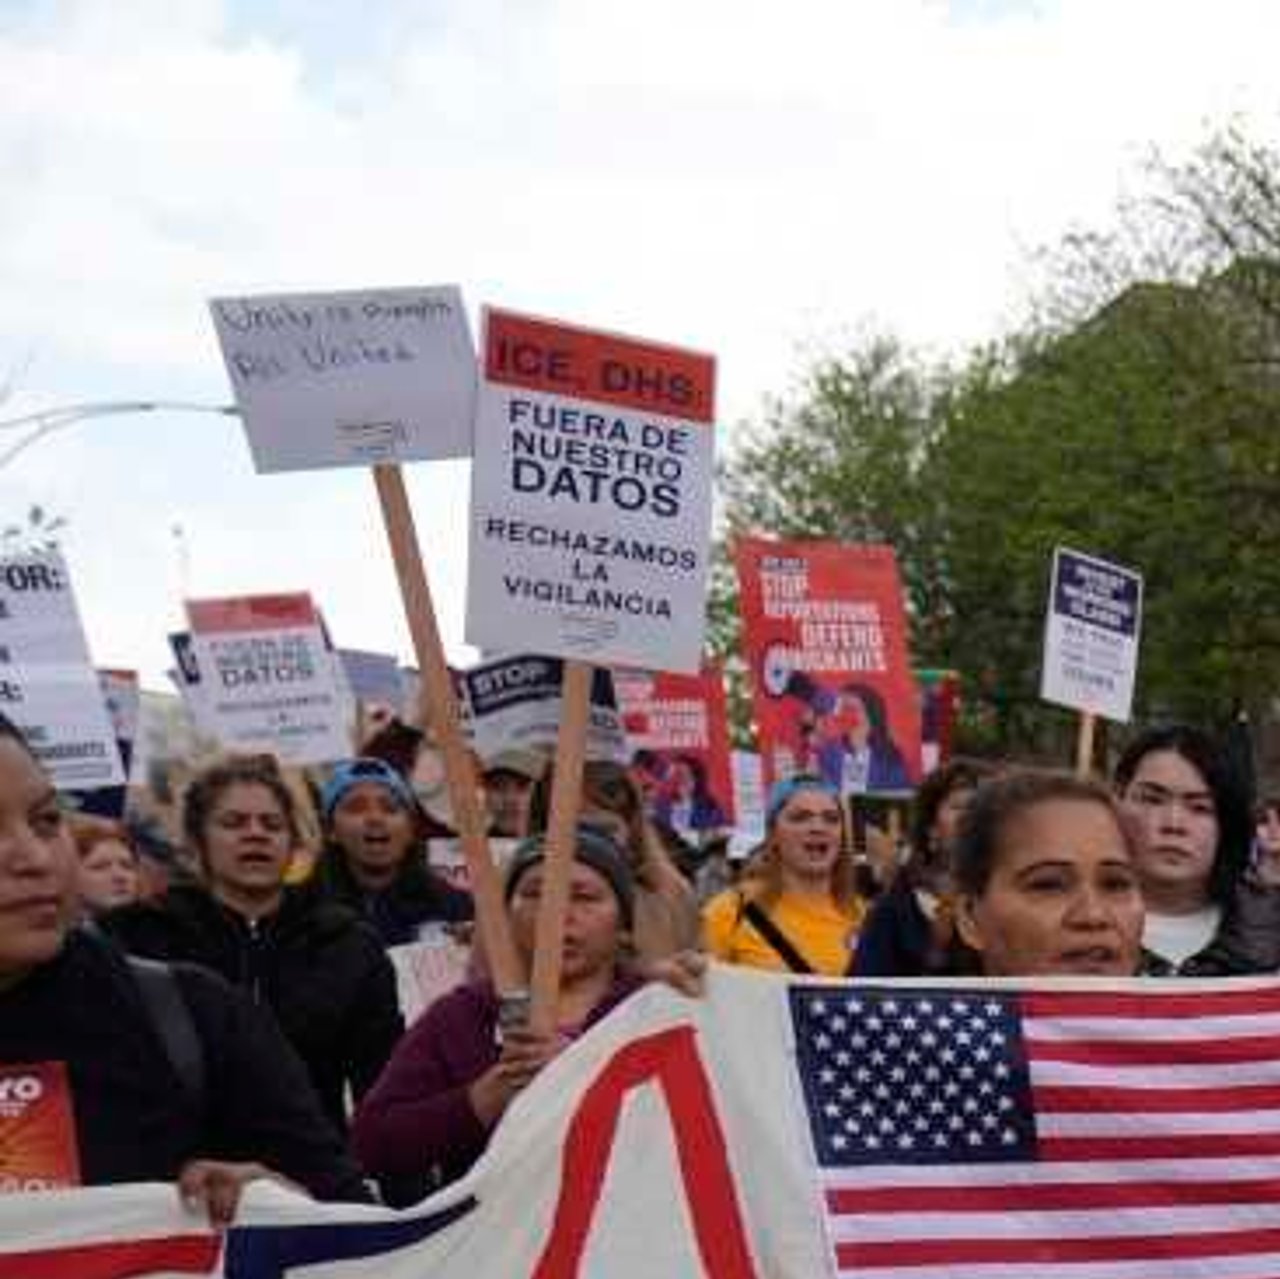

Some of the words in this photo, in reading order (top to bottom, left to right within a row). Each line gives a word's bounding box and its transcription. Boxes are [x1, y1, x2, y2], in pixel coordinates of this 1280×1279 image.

[508, 400, 628, 444] FUERA
[642, 424, 689, 454] DE
[512, 429, 683, 482] NUESTRO
[512, 456, 681, 518] DATOS
[485, 517, 697, 572] RECHAZAMOS
[0, 563, 62, 591] OR:
[573, 558, 609, 583] LA
[503, 574, 672, 619] VIGILANCIA
[472, 661, 548, 695] STOP
